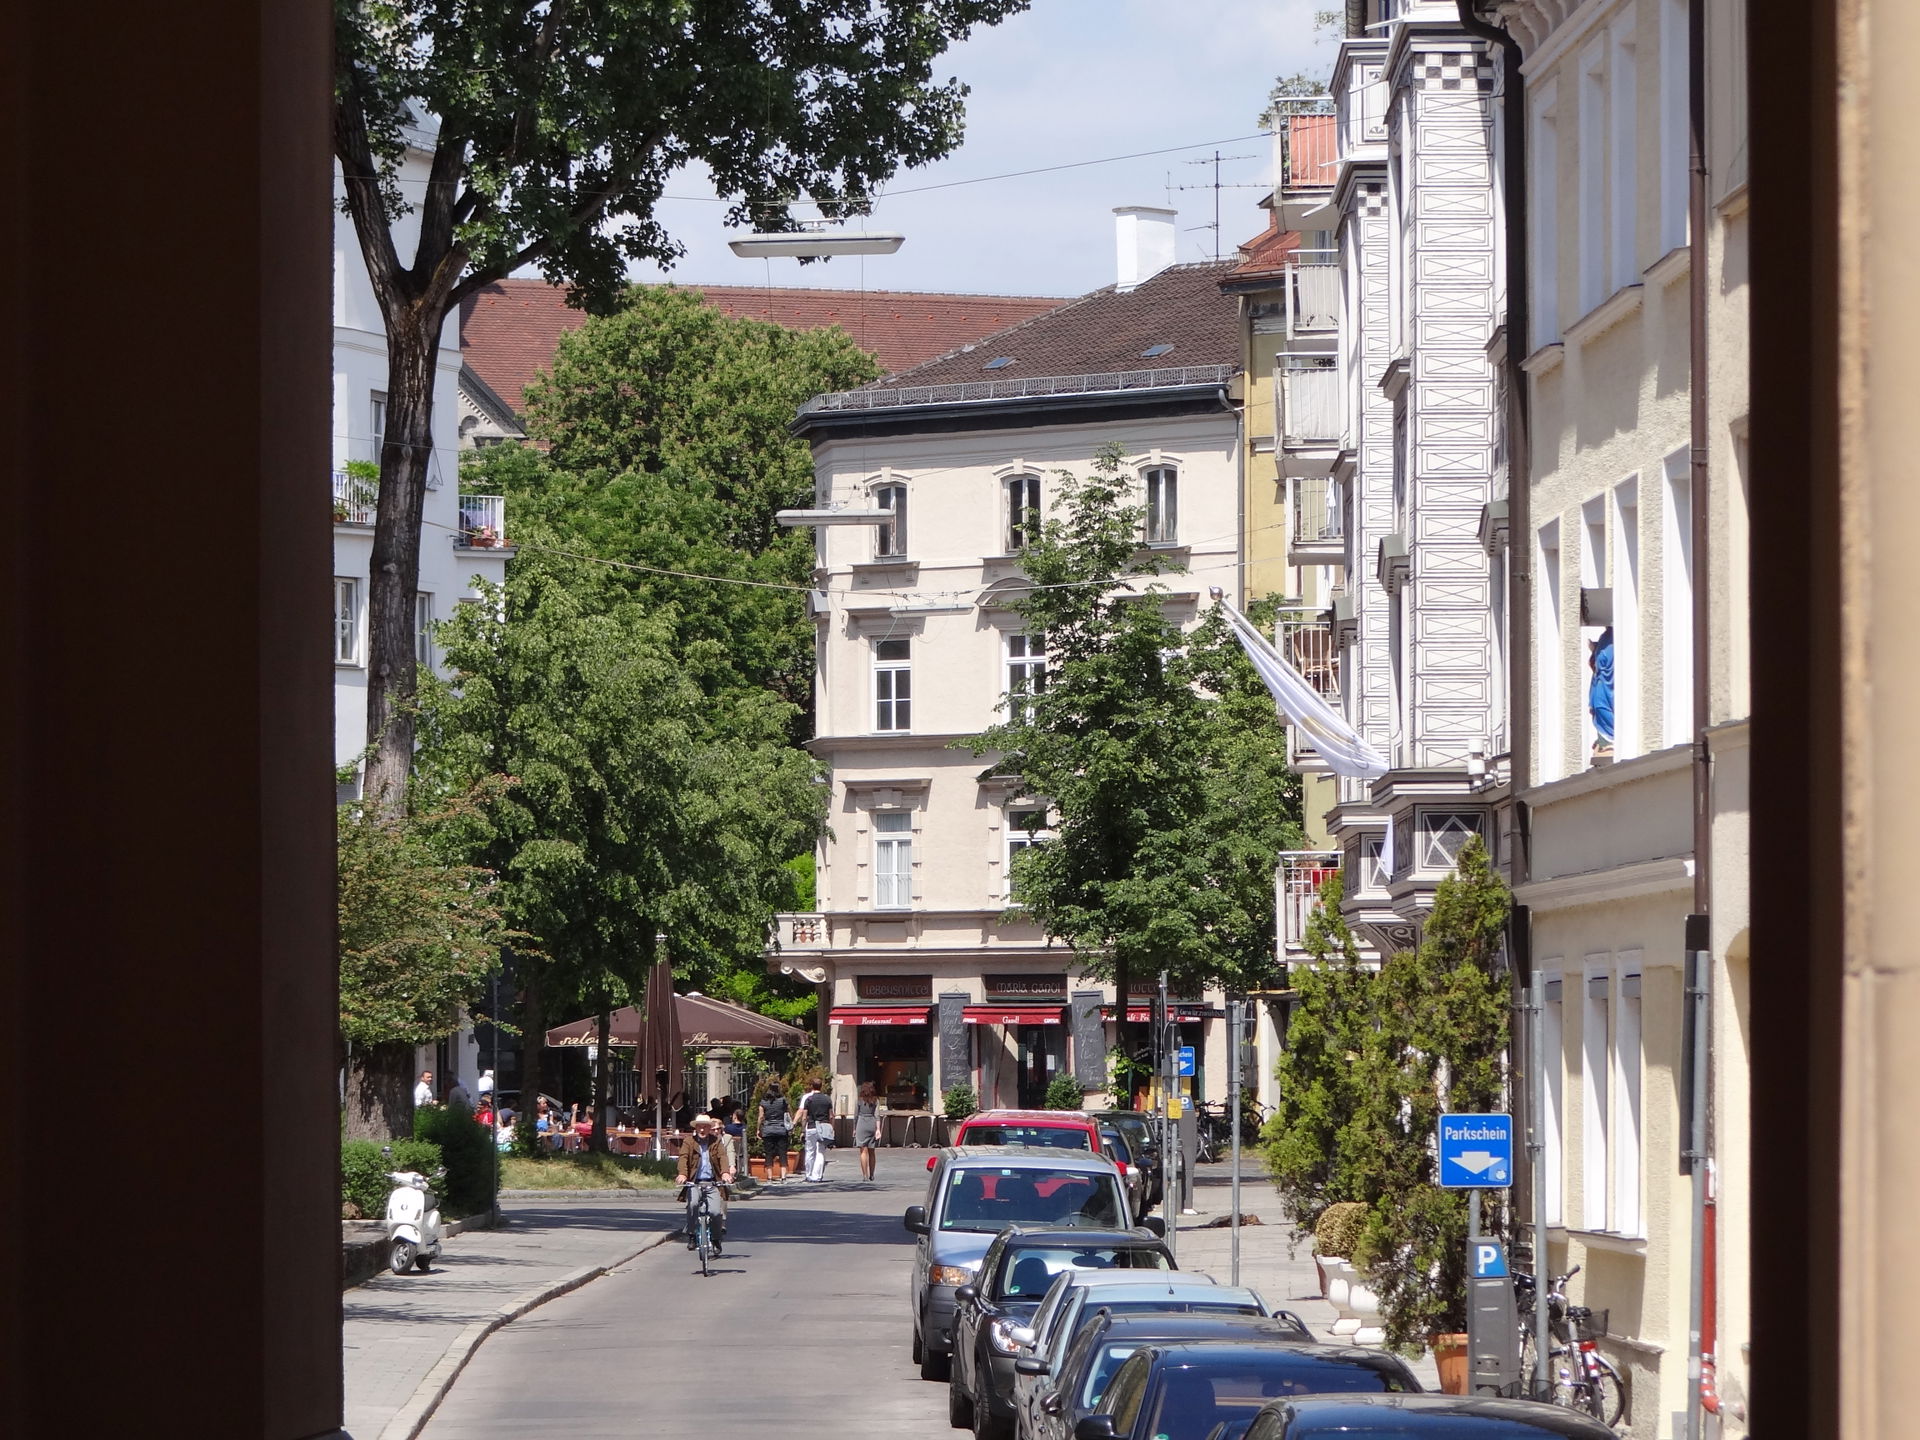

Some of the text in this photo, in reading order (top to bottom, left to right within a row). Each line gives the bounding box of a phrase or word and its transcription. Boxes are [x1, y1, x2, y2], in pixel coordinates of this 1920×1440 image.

[861, 1016, 893, 1025] Restaurant
[1444, 1126, 1507, 1141] Parkschein
[1477, 1245, 1498, 1274] P
